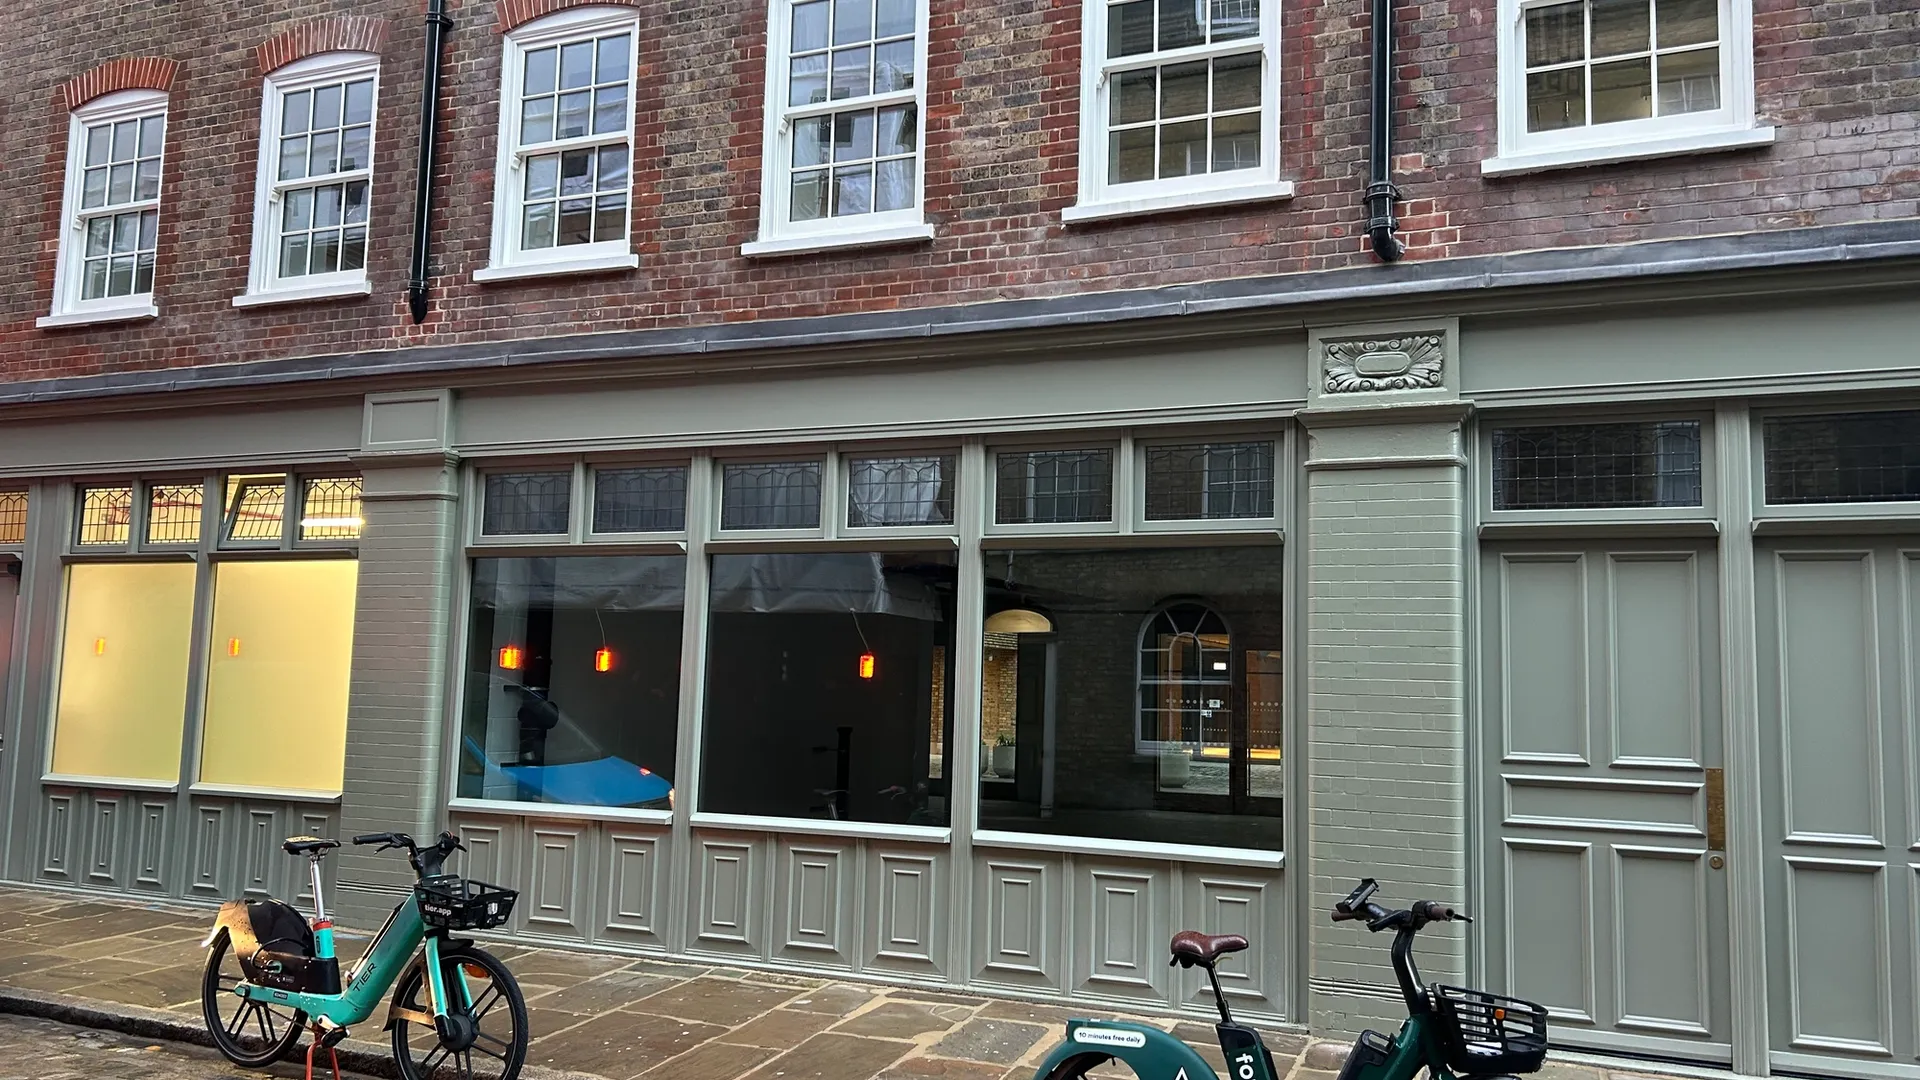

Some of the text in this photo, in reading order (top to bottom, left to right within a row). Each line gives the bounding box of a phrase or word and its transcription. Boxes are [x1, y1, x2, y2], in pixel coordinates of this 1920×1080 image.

[424, 903, 452, 916] tier.app
[353, 963, 377, 992] TIER
[1235, 1053, 1255, 1080] fo
